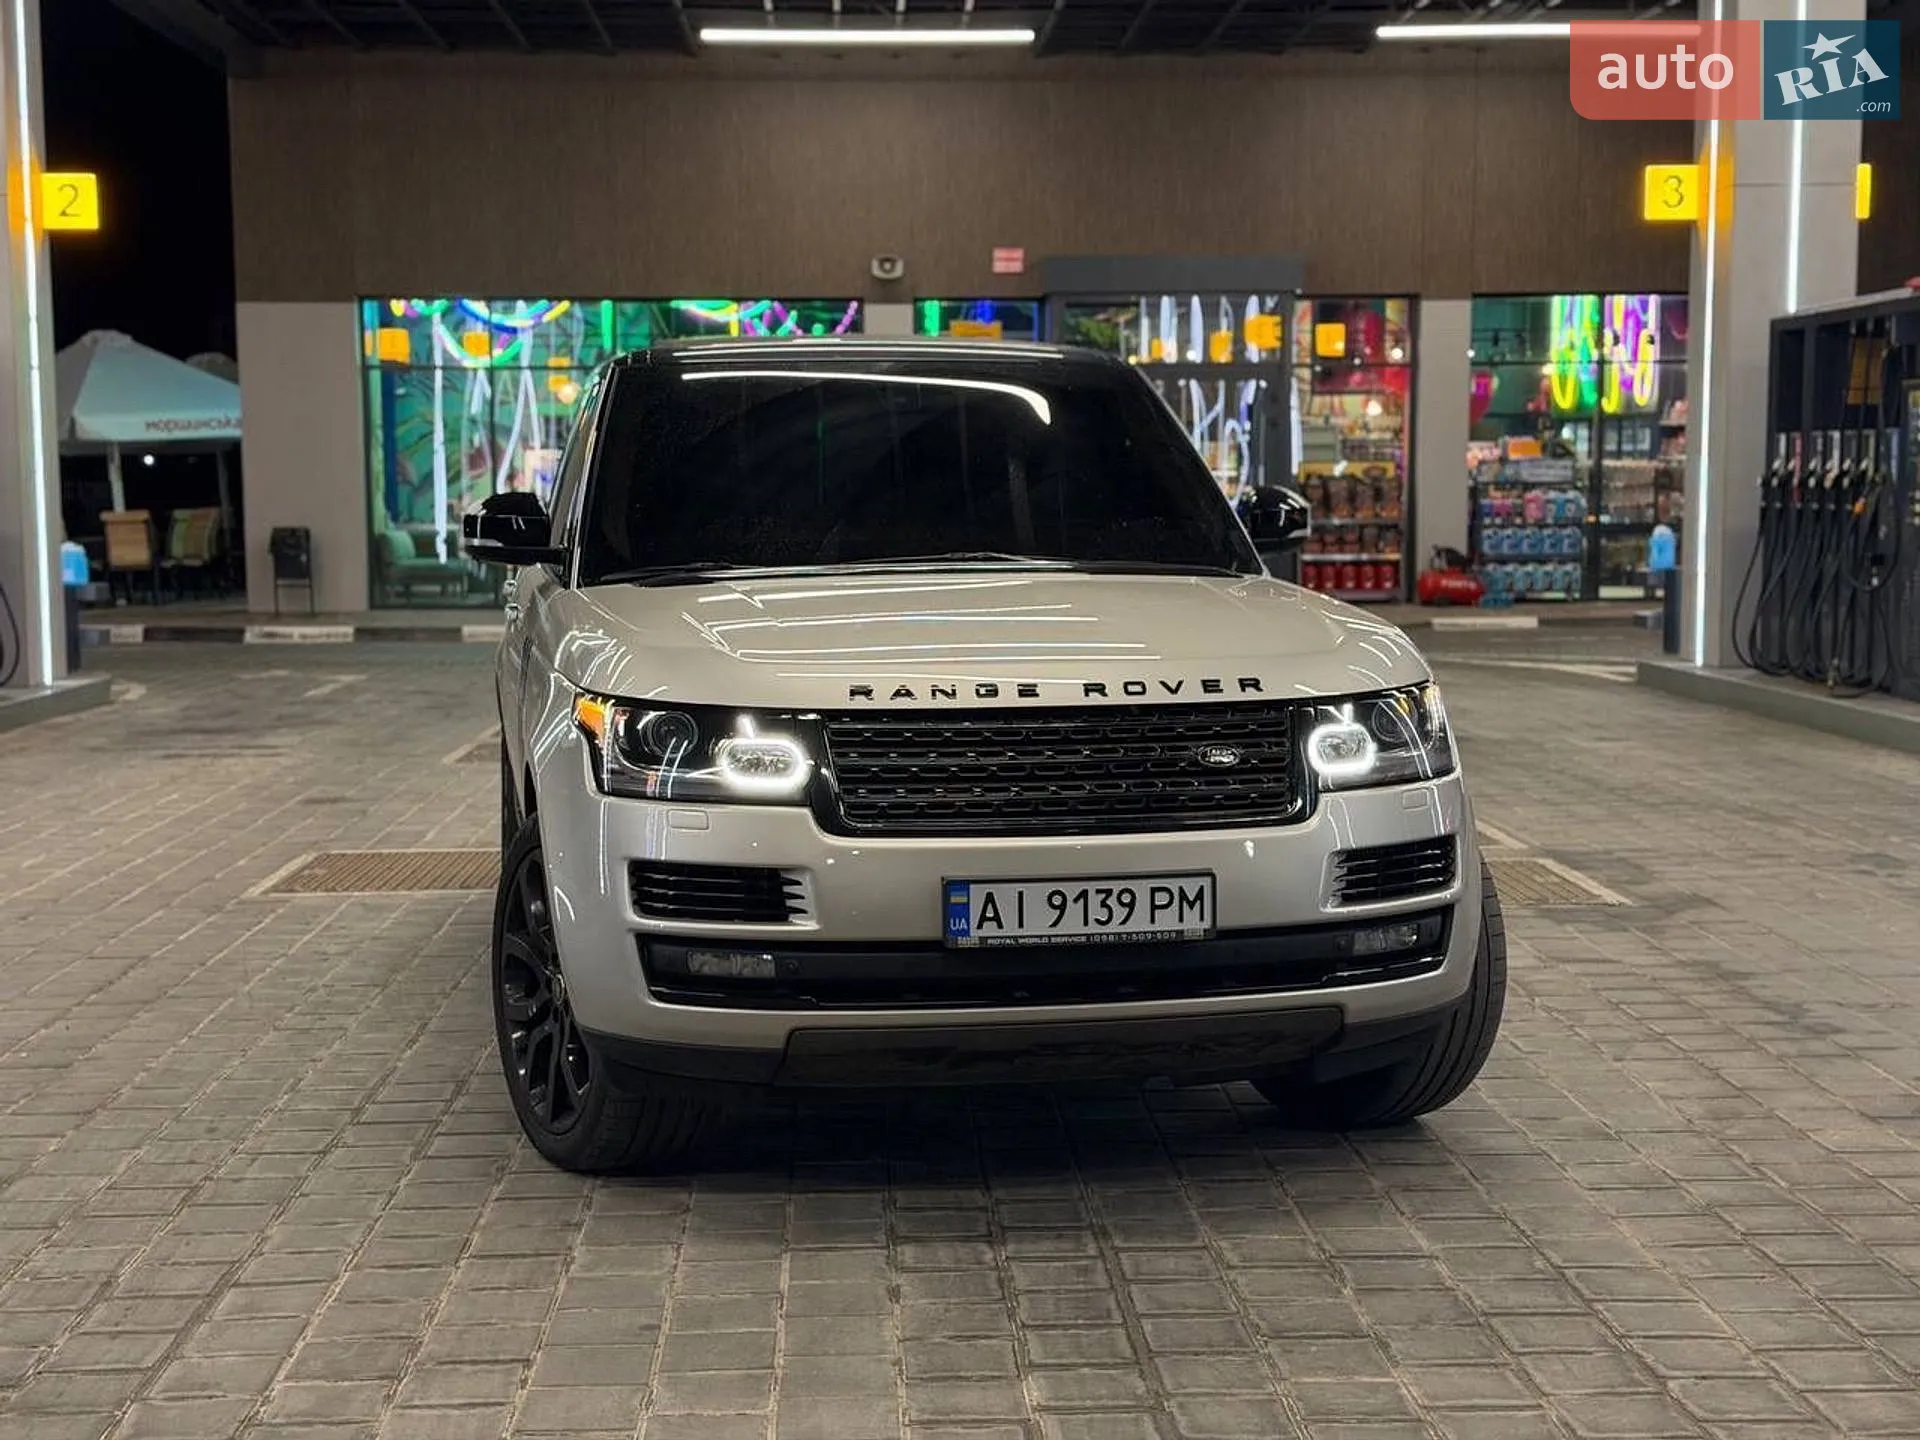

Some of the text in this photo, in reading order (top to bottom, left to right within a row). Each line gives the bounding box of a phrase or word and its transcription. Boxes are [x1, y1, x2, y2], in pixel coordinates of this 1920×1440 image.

[57, 183, 82, 217] 2
[1661, 174, 1685, 209] 3
[848, 677, 1264, 701] RANGE ROVER
[1047, 887, 1137, 928] 9139
[950, 918, 968, 931] UA
[987, 937, 1016, 945] ROYAL
[1018, 935, 1049, 944] WORLD
[1051, 934, 1087, 944] SERVICE
